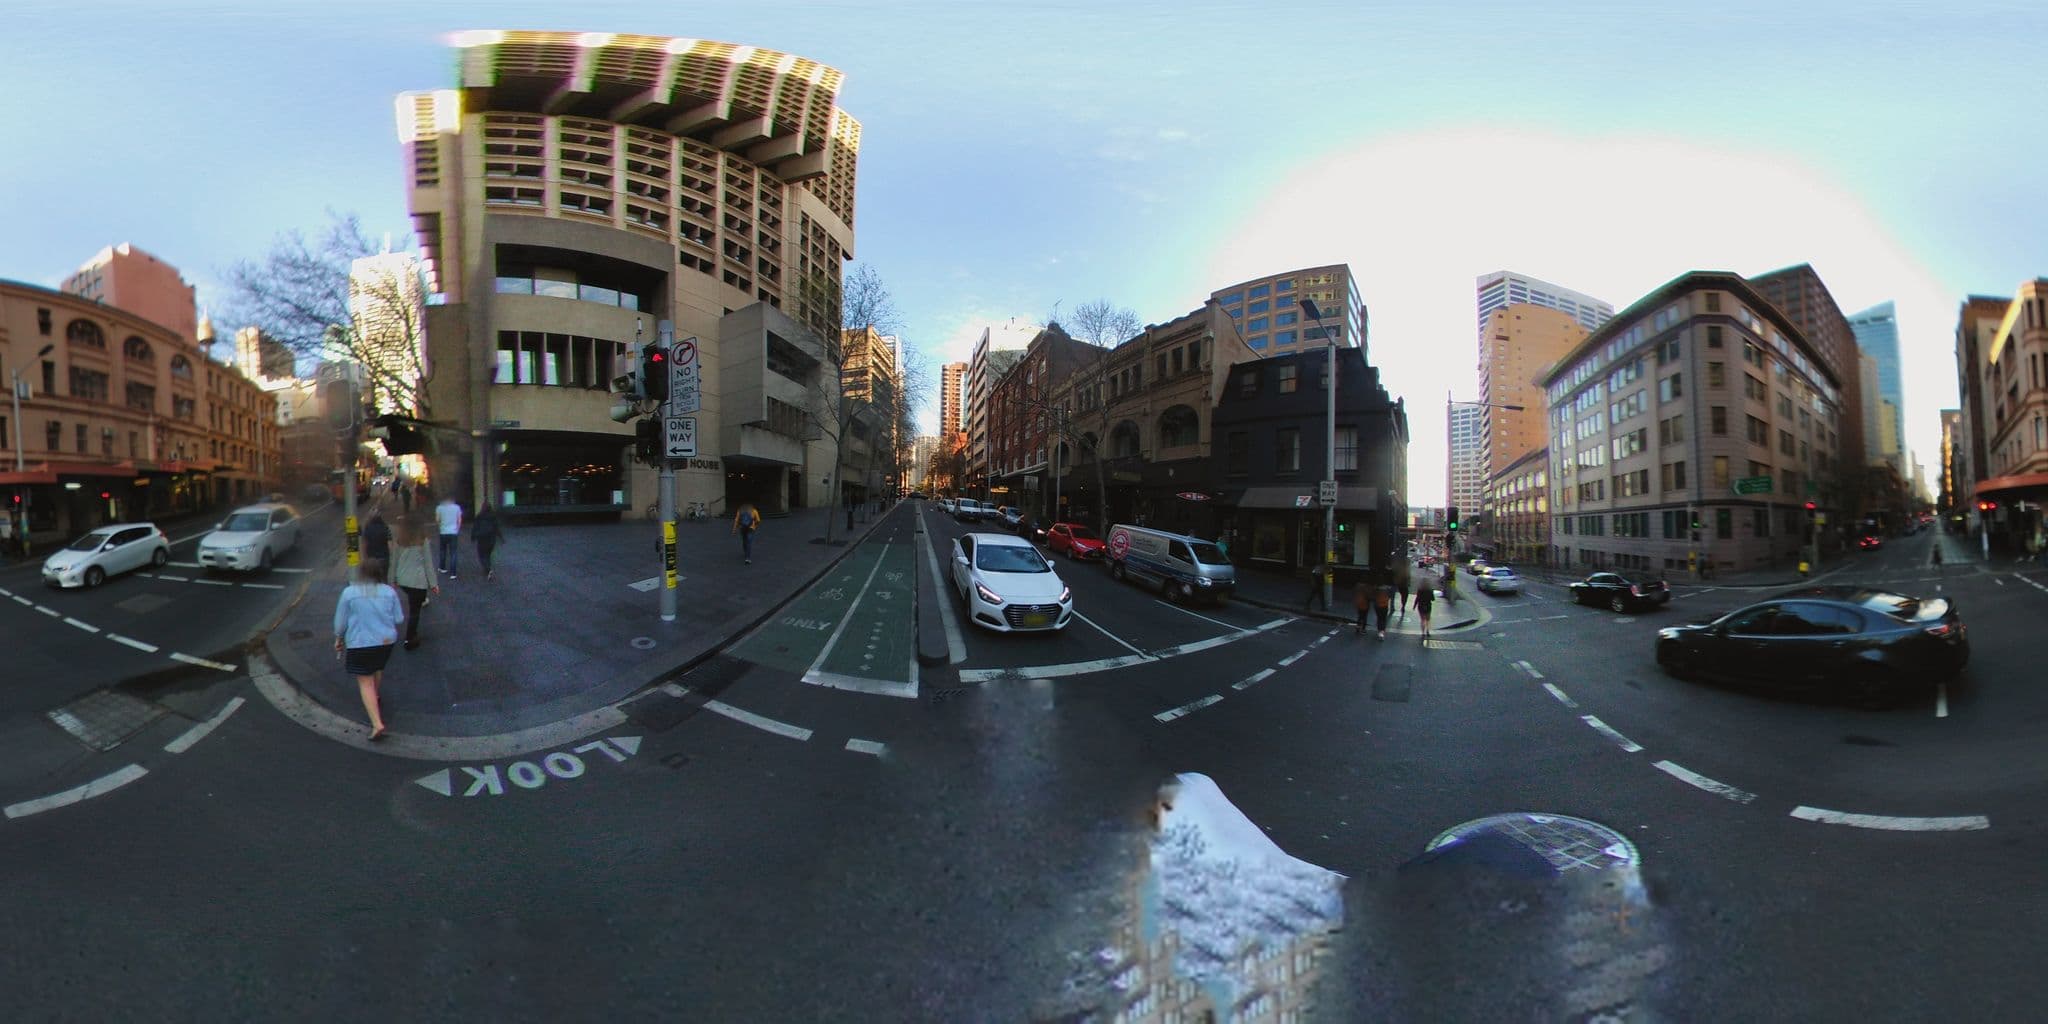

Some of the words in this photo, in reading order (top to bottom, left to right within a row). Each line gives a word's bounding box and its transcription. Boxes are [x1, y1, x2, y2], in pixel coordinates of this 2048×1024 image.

[676, 366, 691, 378] NO
[674, 376, 695, 386] RIGHT
[674, 385, 695, 395] TURN
[669, 421, 692, 430] ONE
[669, 433, 692, 442] WAY
[690, 459, 720, 470] HOUSE
[783, 616, 832, 631] ONLY
[461, 740, 627, 797] LOOK
